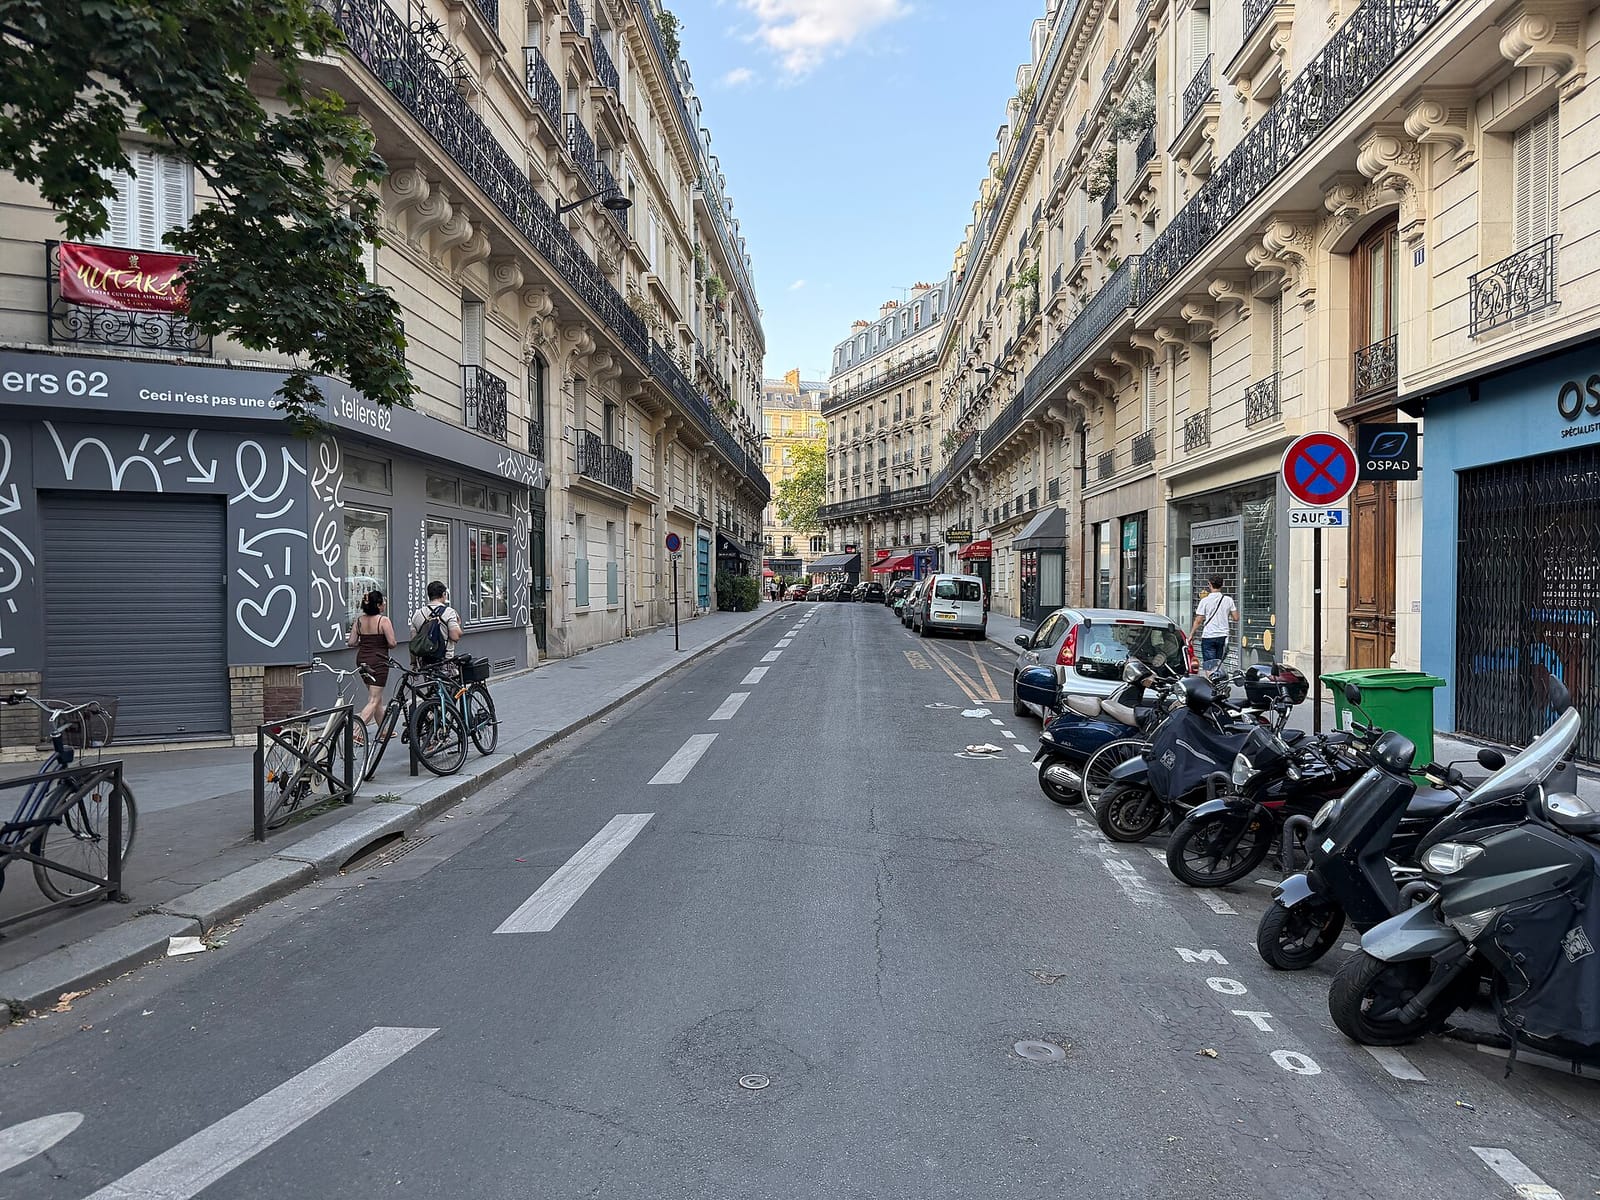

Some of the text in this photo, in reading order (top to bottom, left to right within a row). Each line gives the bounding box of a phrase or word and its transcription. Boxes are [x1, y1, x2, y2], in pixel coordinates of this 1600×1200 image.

[112, 291, 140, 299] CULTUREL
[2, 369, 109, 398] ers 62
[139, 389, 171, 402] Ceci
[175, 391, 209, 404] n'est
[212, 397, 237, 408] pas
[240, 398, 265, 408] une
[333, 394, 392, 432] teliers 62
[1366, 460, 1410, 471] OSPAD
[1095, 644, 1102, 655] A
[1175, 947, 1322, 1076] MOTO
